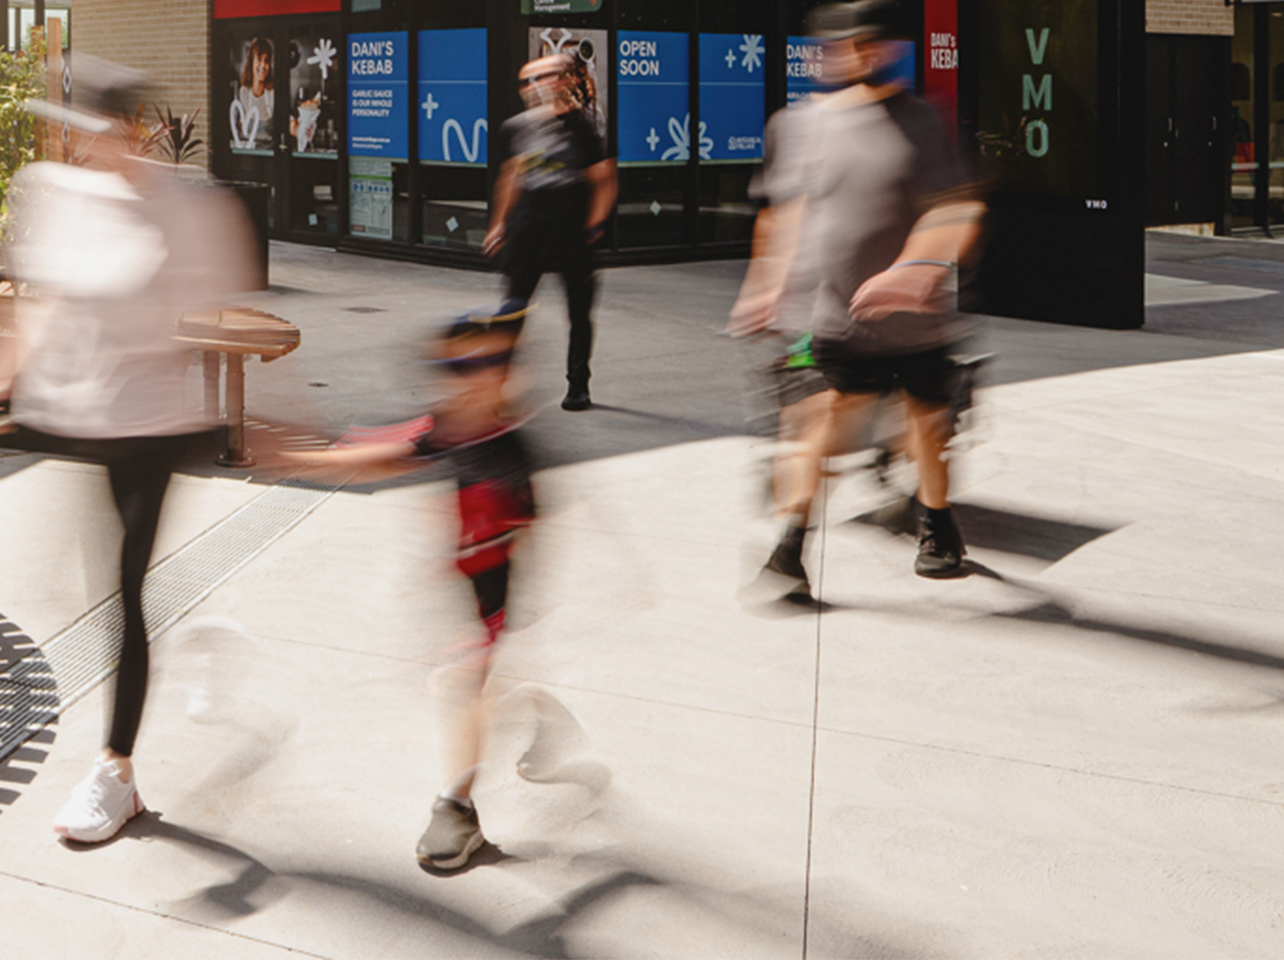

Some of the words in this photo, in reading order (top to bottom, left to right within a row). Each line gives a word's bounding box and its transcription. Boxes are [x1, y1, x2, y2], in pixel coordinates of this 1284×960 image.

[352, 41, 394, 57] DANI'S
[620, 41, 656, 57] OPEN
[786, 45, 824, 60] DANI'S
[931, 49, 958, 69] KEBA
[352, 60, 393, 75] KEBAB
[620, 60, 660, 76] SOON
[786, 63, 823, 77] KEBAB
[1022, 28, 1053, 157] VMO
[1085, 199, 1108, 209] VMO
